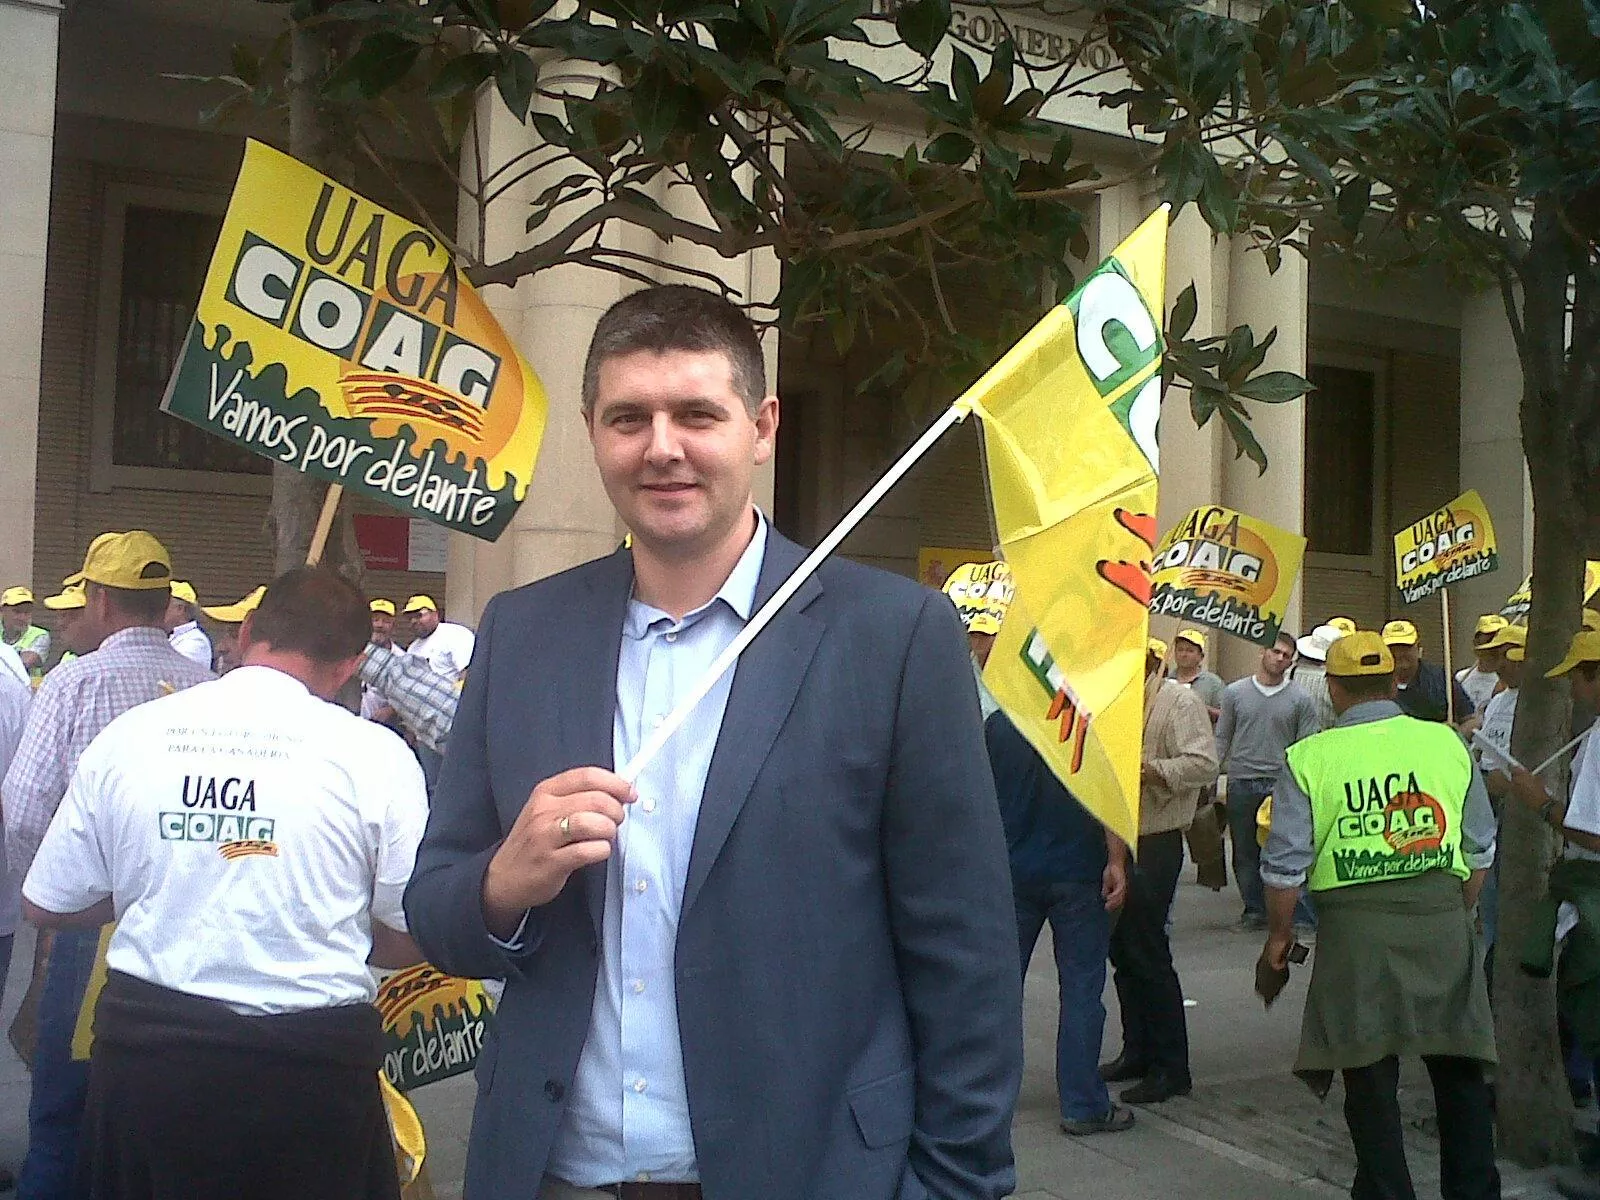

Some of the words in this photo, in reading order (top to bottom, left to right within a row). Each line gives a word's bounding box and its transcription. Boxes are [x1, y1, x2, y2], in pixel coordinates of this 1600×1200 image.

[305, 182, 458, 327] UAGA
[230, 238, 499, 408] COAG
[206, 362, 307, 462] Vamos
[300, 424, 373, 477] por
[365, 440, 496, 526] delante
[1170, 507, 1240, 547] UAGA
[1403, 523, 1474, 573] COAG
[1413, 508, 1456, 545] UAGA
[1403, 579, 1432, 604] Vamos
[1446, 556, 1491, 583] delante
[1160, 593, 1197, 615] por
[1191, 596, 1266, 639] delante
[182, 775, 257, 812] UAGA
[1344, 771, 1426, 813] UAGA
[159, 812, 275, 842] COAG
[1338, 805, 1436, 839] COAG
[1344, 859, 1382, 879] Vamos
[1384, 860, 1405, 877] por
[1404, 851, 1448, 873] delante
[384, 1046, 409, 1085] or
[412, 1008, 485, 1077] delante
